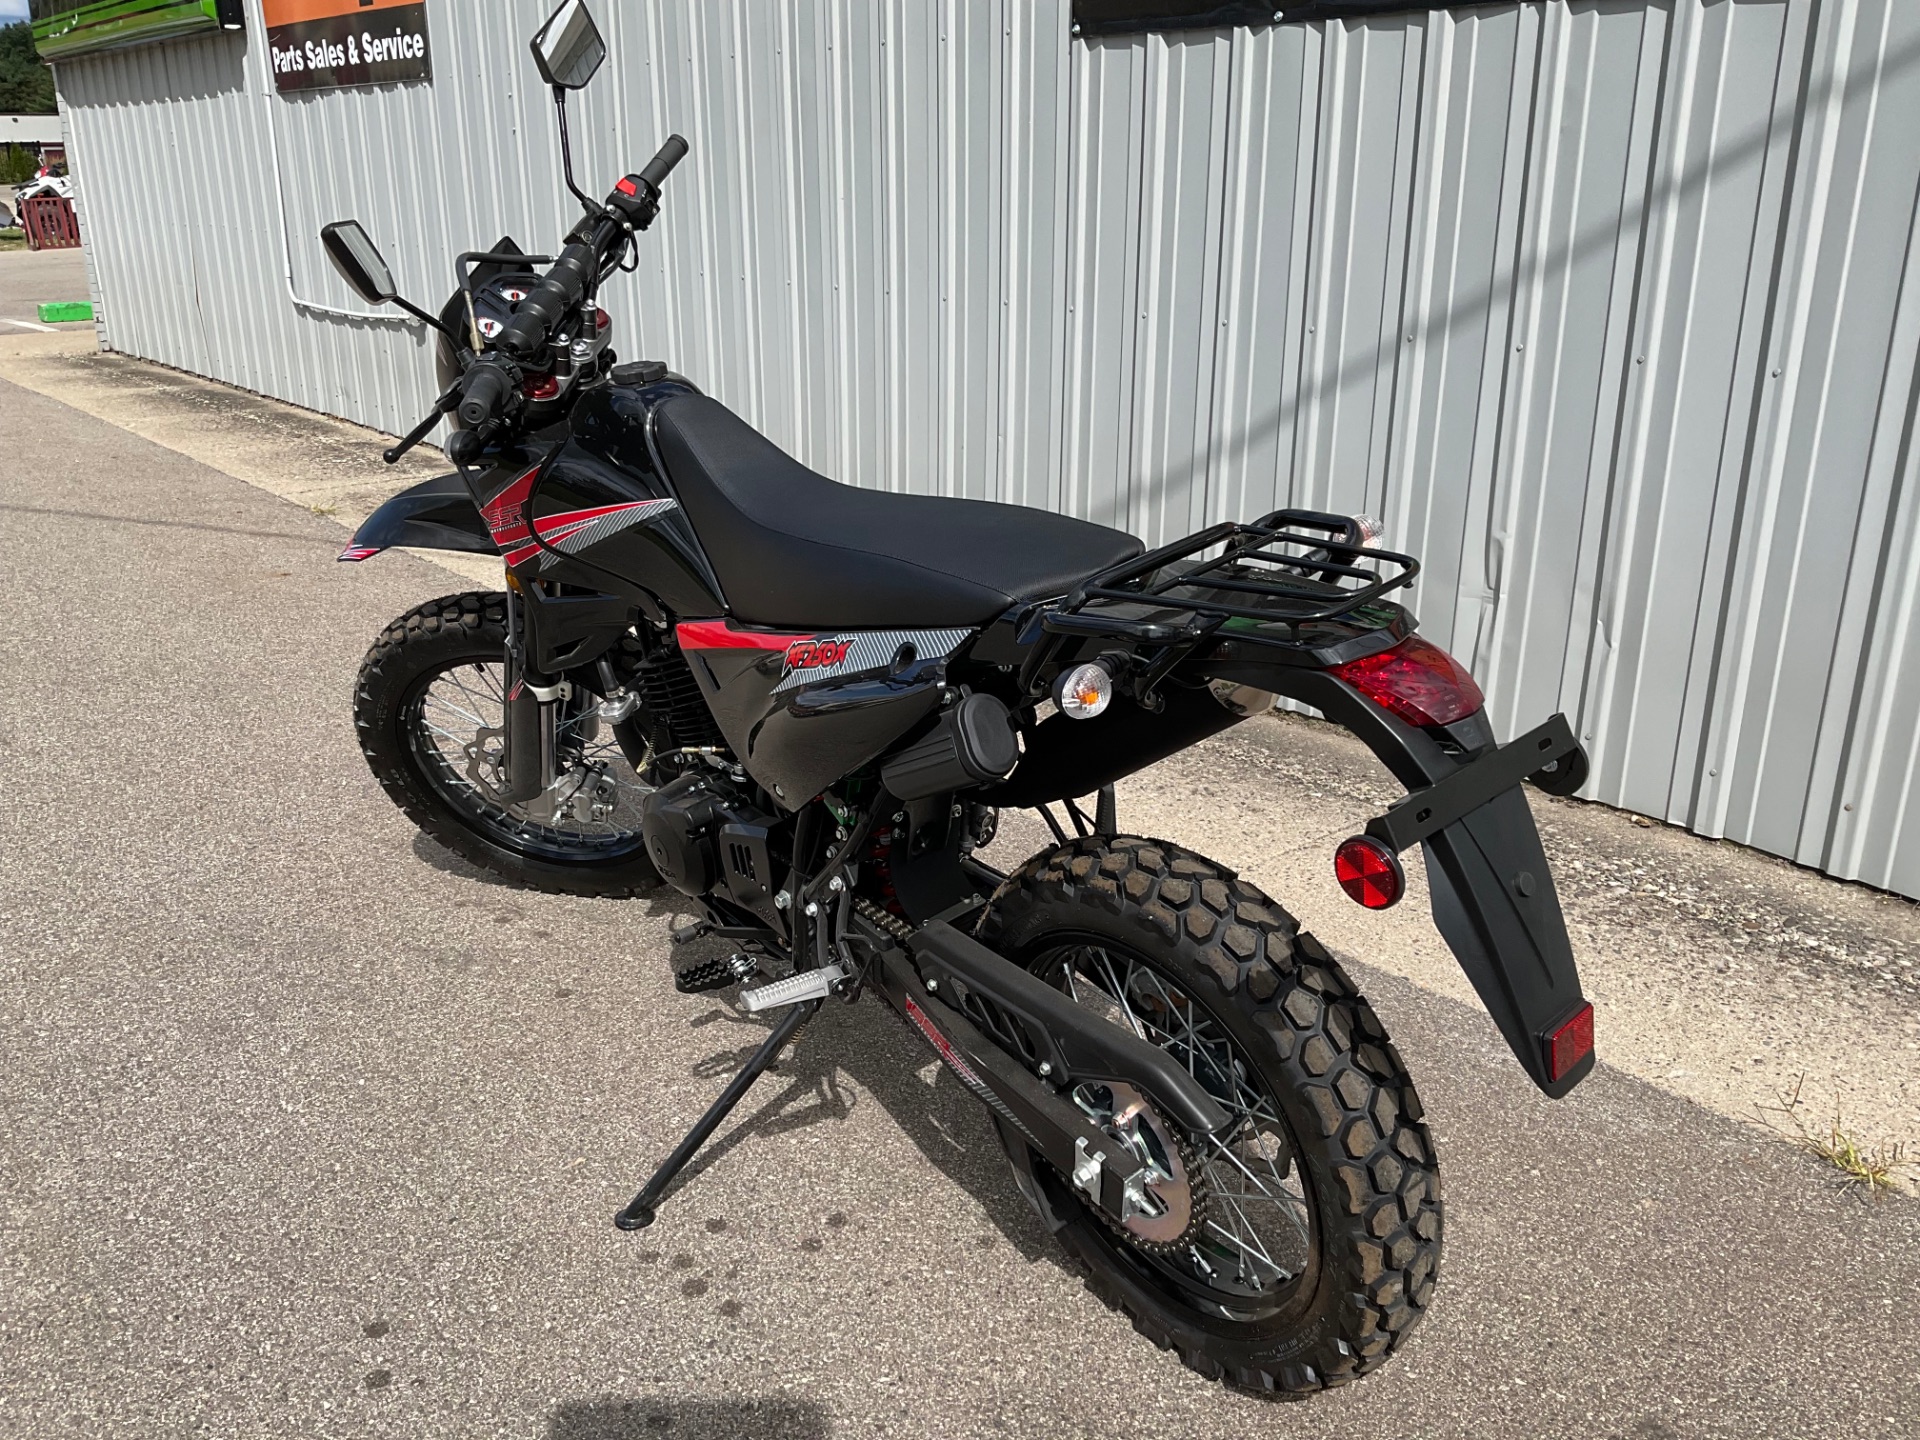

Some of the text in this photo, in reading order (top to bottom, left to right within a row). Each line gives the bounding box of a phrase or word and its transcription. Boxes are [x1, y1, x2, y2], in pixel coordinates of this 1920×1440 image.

[272, 27, 424, 74] Parts Sales & Service
[489, 503, 527, 529] SSR
